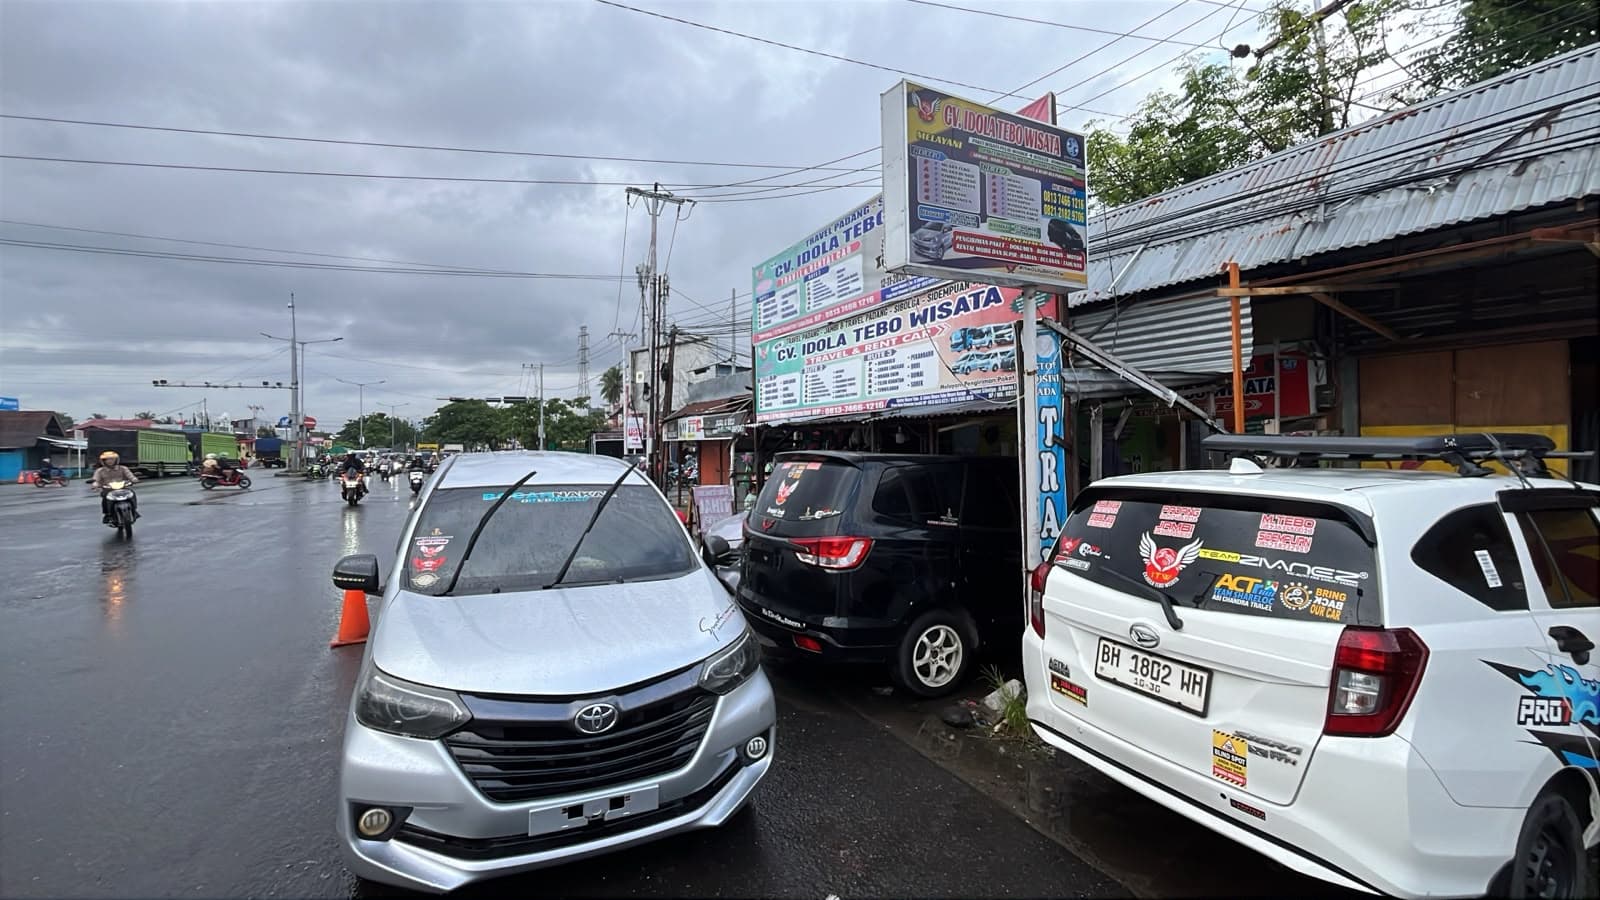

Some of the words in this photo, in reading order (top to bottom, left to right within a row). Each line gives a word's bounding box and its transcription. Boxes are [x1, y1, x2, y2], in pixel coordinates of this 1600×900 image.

[944, 104, 962, 129] CV.
[964, 111, 996, 139] IDOLA
[996, 118, 1023, 146] TEBO
[1023, 126, 1062, 157] WISATA
[806, 228, 832, 247] TRAVEL
[834, 205, 870, 232] PADANG
[775, 260, 794, 278] CV.
[797, 235, 839, 266] IDOLA
[865, 307, 888, 322] PADANG
[894, 298, 920, 313] SIBOLGA
[927, 281, 970, 301] SIDEMPUAN
[777, 346, 798, 362] CV.
[802, 333, 847, 356] IDOLA
[853, 317, 902, 343] TEBO
[910, 287, 1003, 328] WISATA
[810, 351, 849, 366] TRAVEL
[865, 338, 898, 351] RENT
[902, 331, 929, 343] CAR
[1038, 387, 1057, 396] ADA
[1156, 520, 1194, 532] JAMBI
[1262, 514, 1315, 528] M.TEBO
[1202, 550, 1239, 561] TEAM
[1214, 573, 1263, 594] ACT
[1213, 587, 1234, 599] TEAM
[1234, 590, 1276, 606] SHARELOC
[1315, 587, 1348, 601] BRING
[1310, 603, 1324, 617] OUR
[1325, 606, 1342, 620] CAR
[1101, 644, 1121, 668] BH
[1129, 654, 1172, 686] 1802
[1180, 669, 1205, 697] WH
[1133, 677, 1161, 693] 10-30
[1214, 747, 1231, 760] BLIND
[1231, 753, 1246, 767] SPOT
